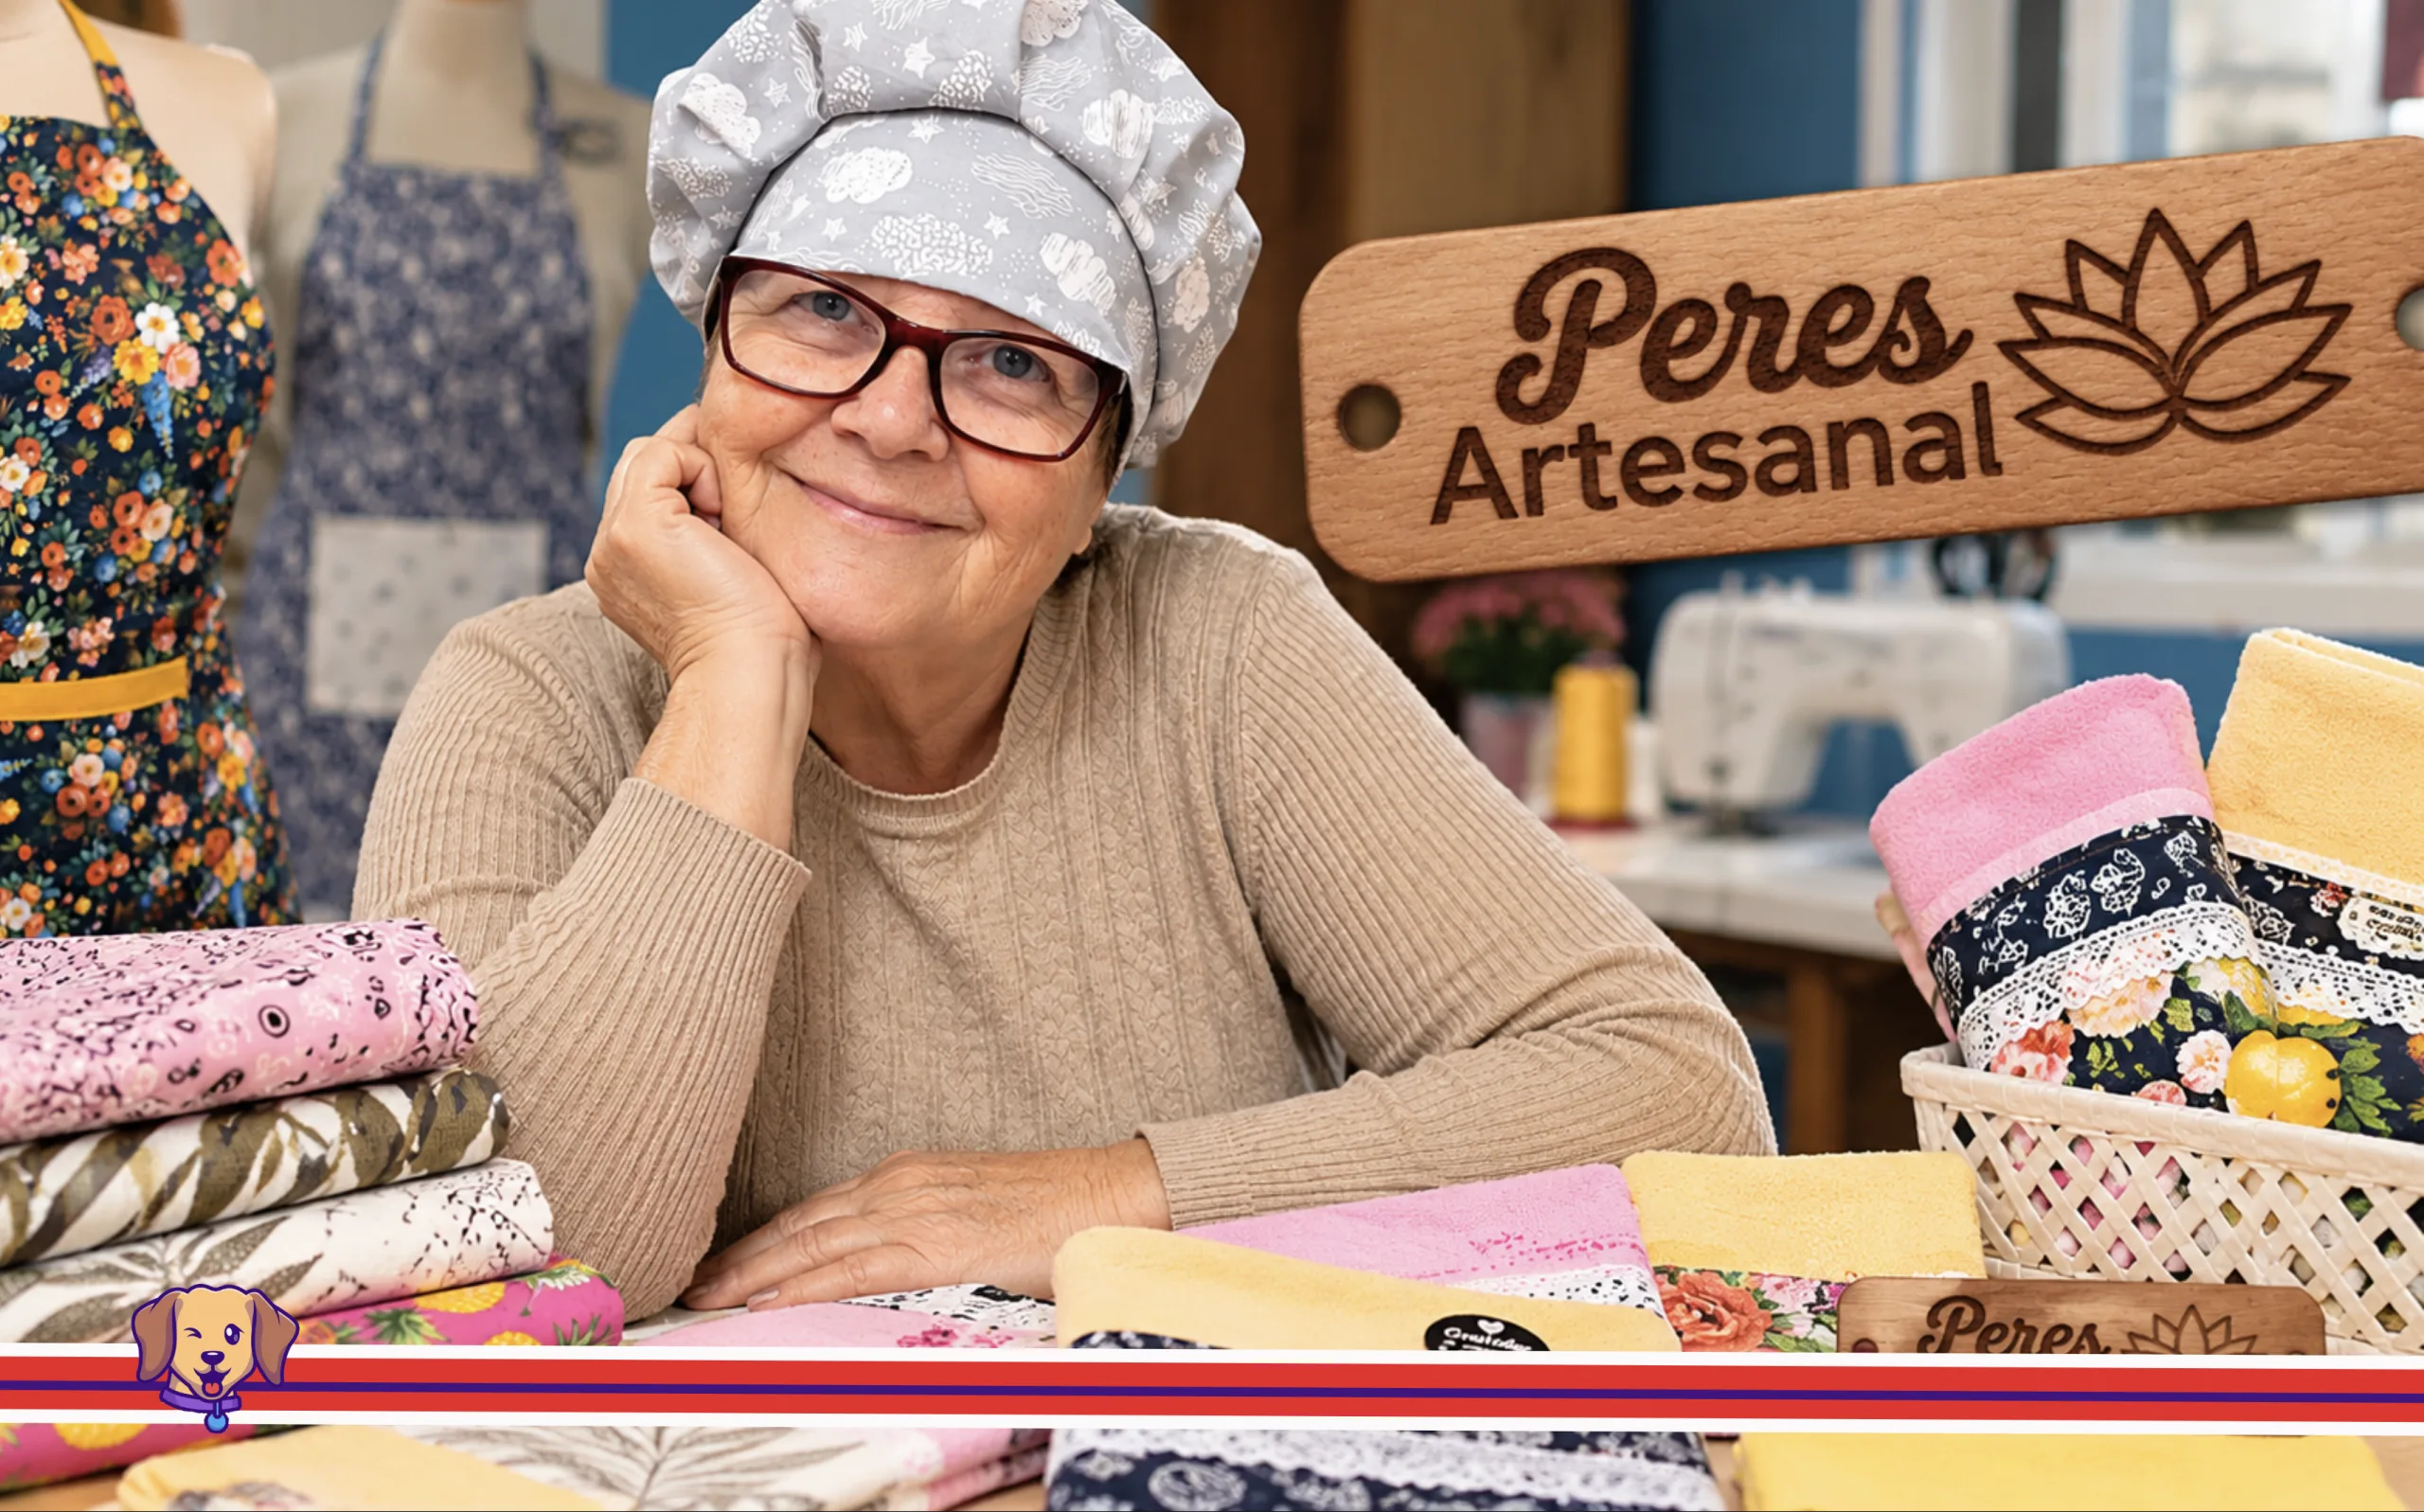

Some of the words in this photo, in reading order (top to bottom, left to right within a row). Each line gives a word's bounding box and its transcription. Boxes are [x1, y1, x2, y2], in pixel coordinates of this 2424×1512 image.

[1494, 245, 1975, 426] Peres
[1429, 380, 2004, 526] Artesanal
[1916, 1294, 2112, 1354] Peres
